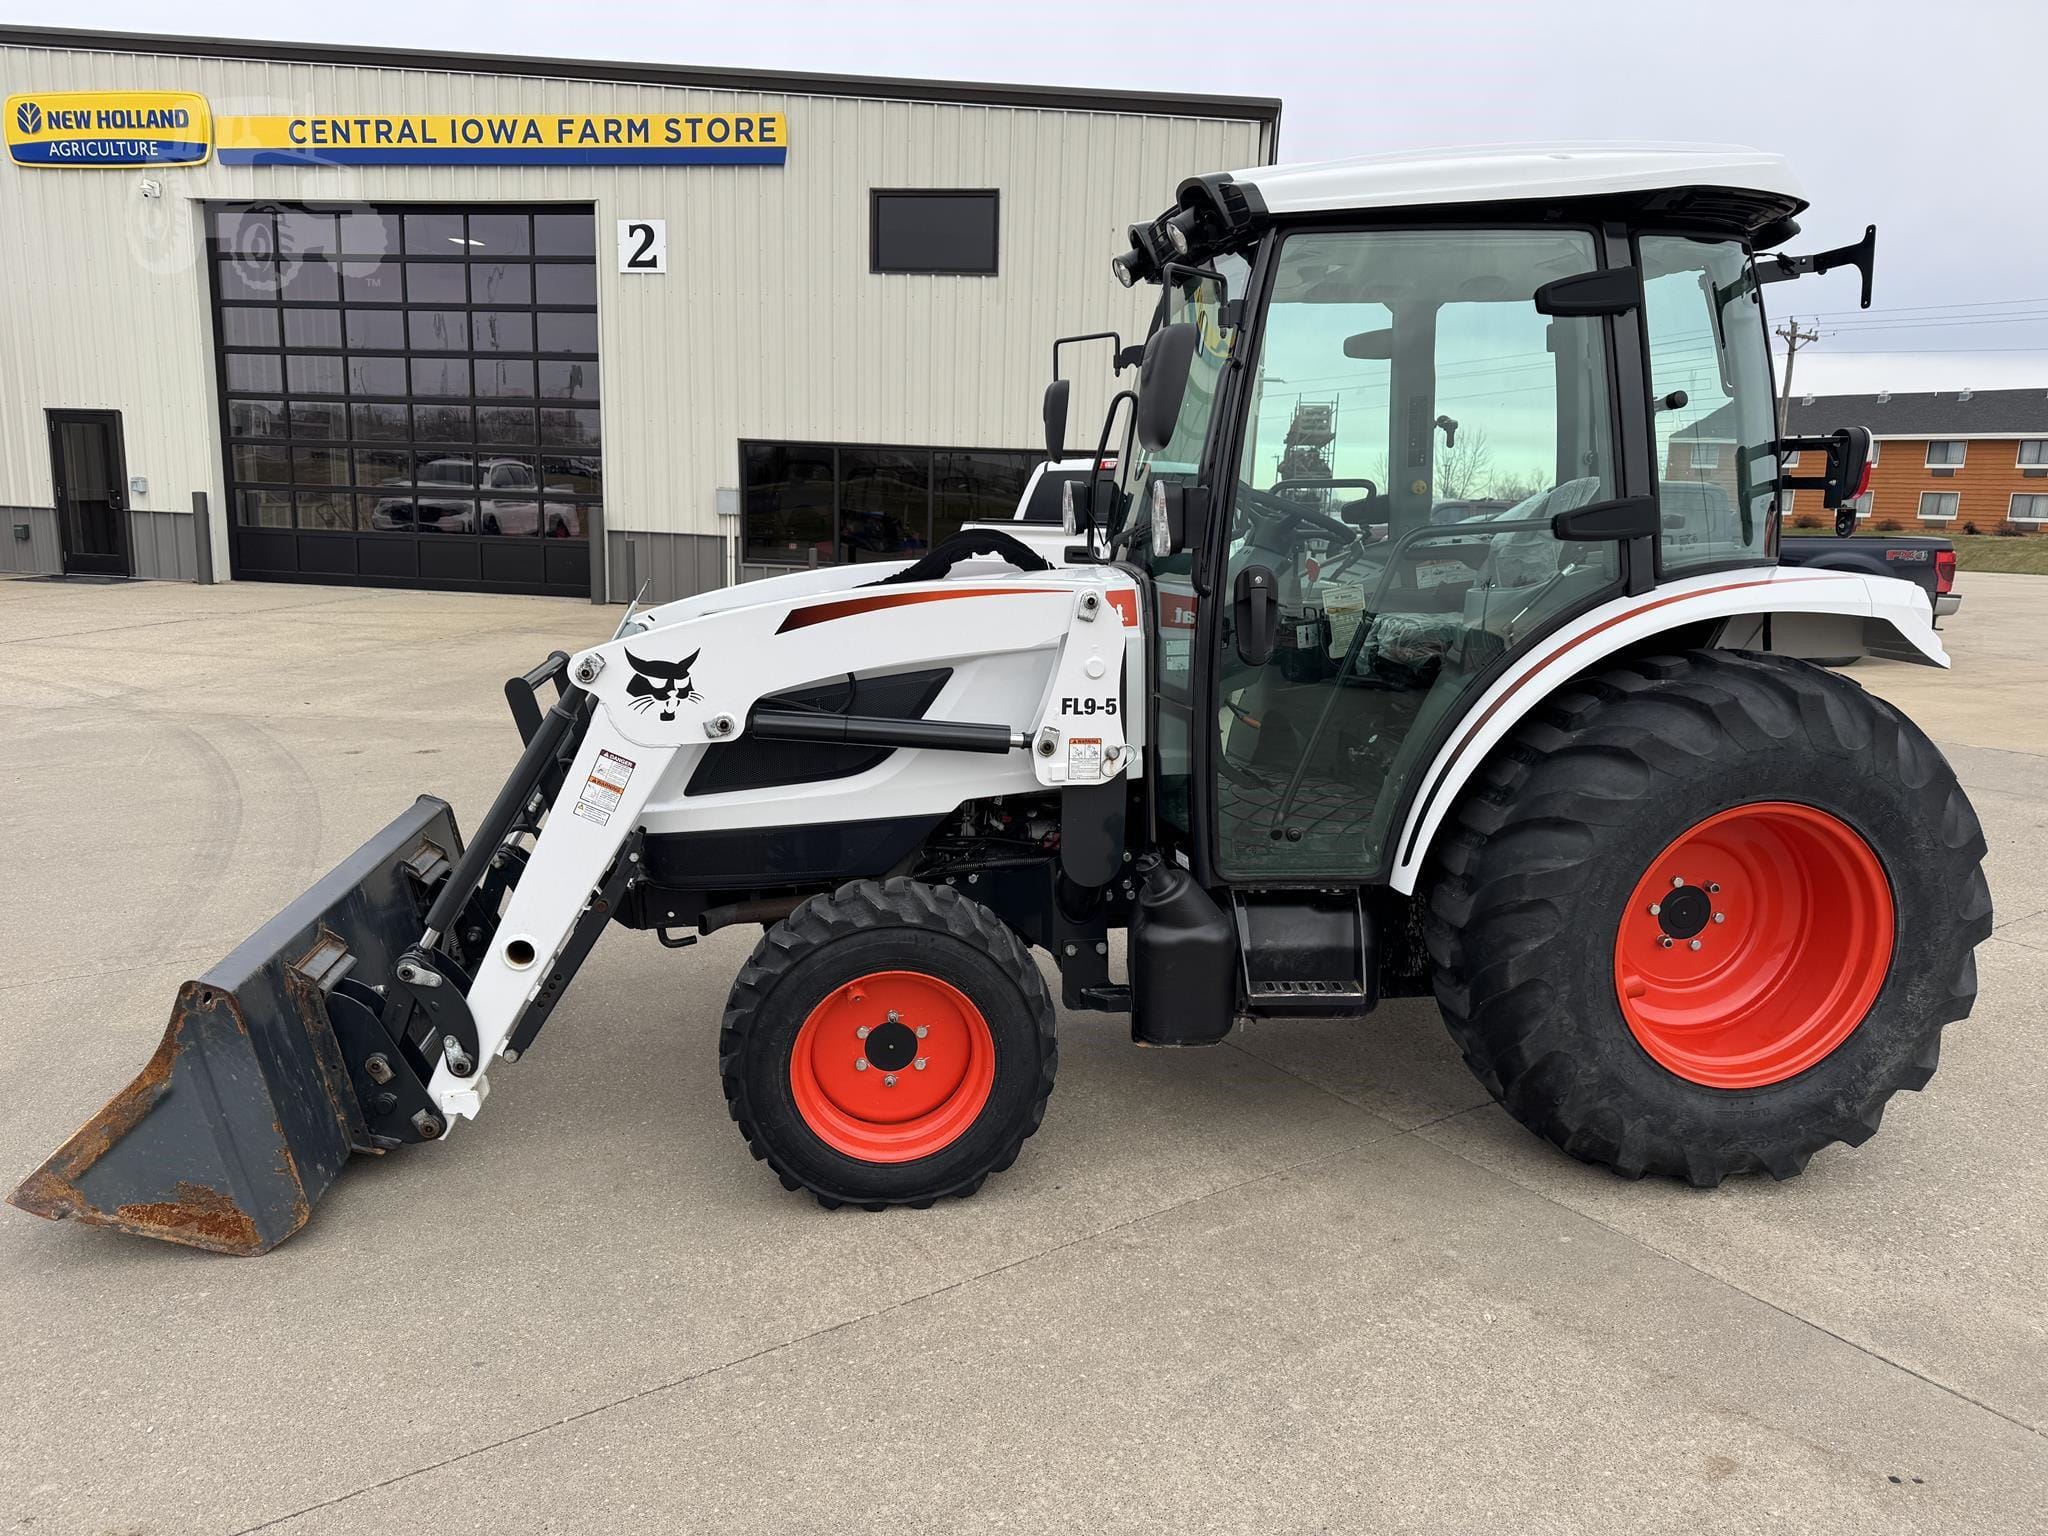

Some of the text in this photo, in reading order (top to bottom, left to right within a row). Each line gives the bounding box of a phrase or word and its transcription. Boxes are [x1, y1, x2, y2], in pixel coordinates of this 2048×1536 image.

[47, 108, 190, 130] NEW HOLLAND
[288, 116, 777, 144] CENTRAL IOWA FARM STORE
[48, 140, 159, 157] AGRICULTURE
[626, 222, 658, 269] 2
[1060, 697, 1117, 716] FL9-5
[609, 754, 633, 767] DANGER
